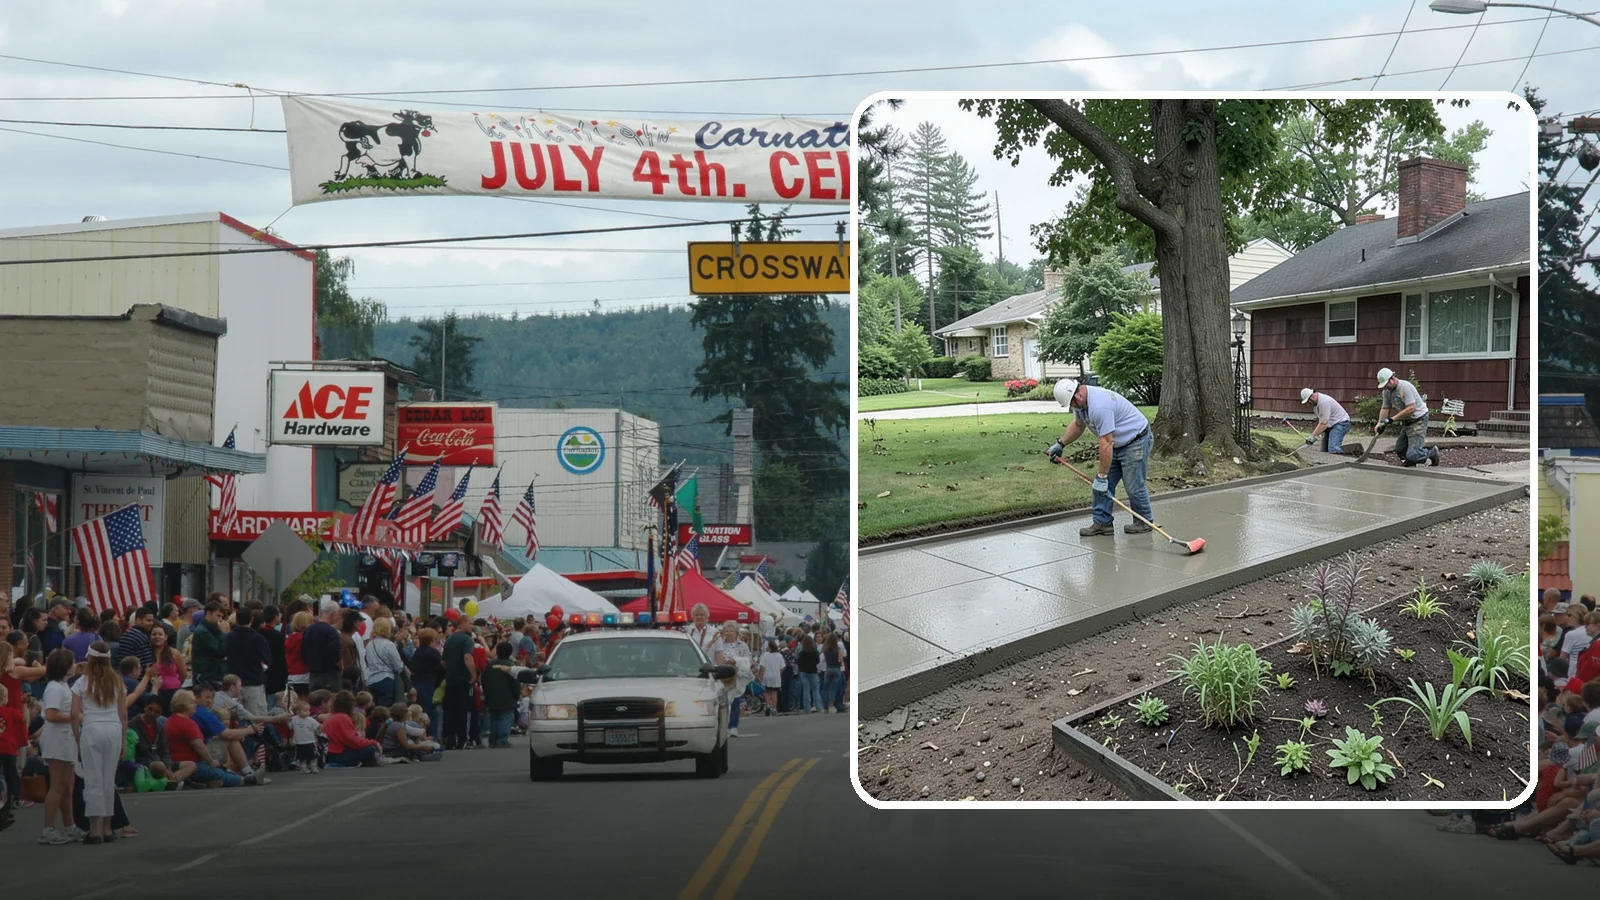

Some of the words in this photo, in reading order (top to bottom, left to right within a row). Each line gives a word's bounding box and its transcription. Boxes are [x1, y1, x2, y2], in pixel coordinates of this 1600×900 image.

[481, 141, 604, 193] JULY
[632, 149, 746, 198] 4th.
[697, 254, 850, 280] CROSSWA
[283, 380, 373, 420] ACE
[405, 409, 452, 422] CEDAR
[461, 409, 485, 422] LOG
[283, 421, 370, 436] Hardware
[416, 428, 476, 447] Coca-Cola
[353, 467, 385, 480] Simpl
[83, 484, 93, 494] St.
[96, 485, 124, 495] Vincent
[126, 485, 136, 495] de
[137, 485, 155, 495] Paul
[212, 516, 330, 536] HARDARE
[688, 527, 741, 535] CRNATION
[699, 535, 730, 543] GLASS
